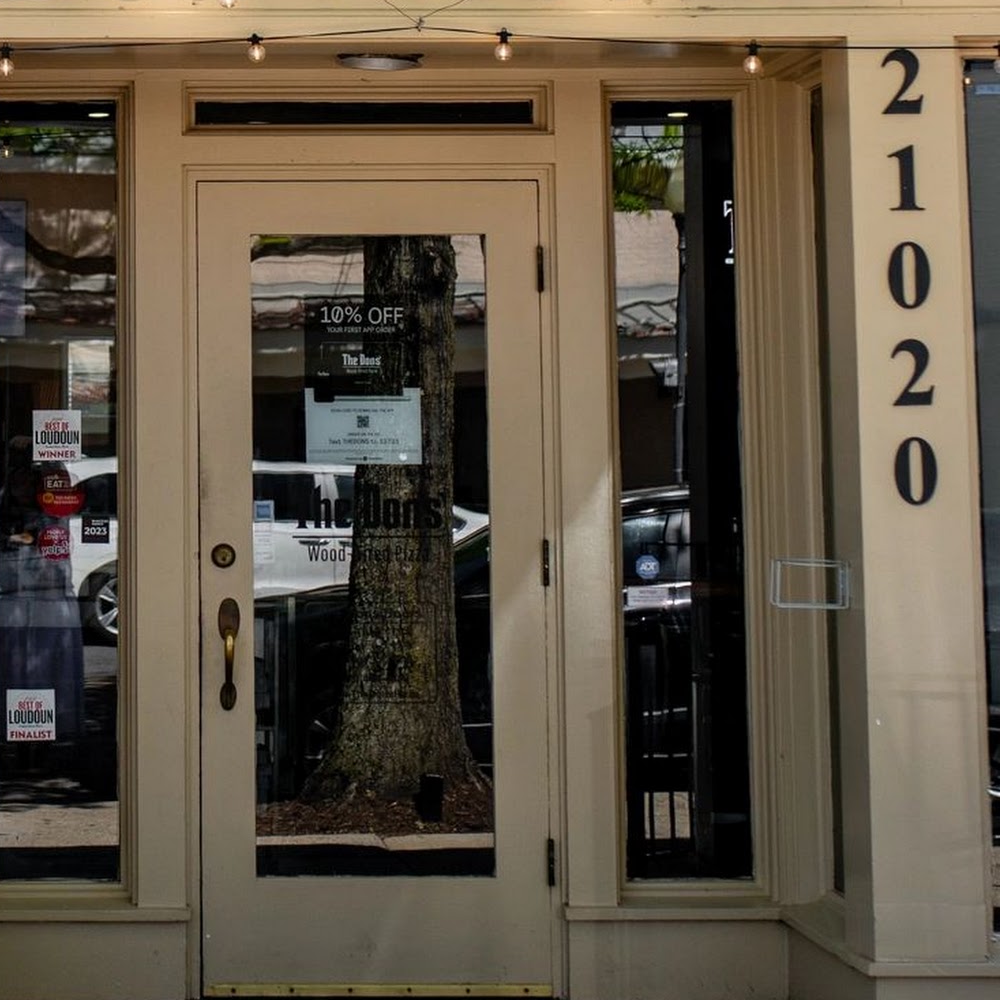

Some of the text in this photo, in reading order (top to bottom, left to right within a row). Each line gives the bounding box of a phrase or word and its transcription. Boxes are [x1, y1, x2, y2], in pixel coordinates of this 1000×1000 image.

[880, 48, 938, 506] 21020
[320, 305, 405, 325] 10% OFF
[342, 353, 359, 366] The
[44, 421, 69, 431] BEST OF
[35, 430, 79, 445] LOUDOUN
[38, 450, 77, 458] WINNER
[83, 526, 108, 536] 2023
[18, 700, 43, 710] BEST OF
[8, 709, 54, 724] LOUDOUN
[9, 730, 52, 739] FINALIST
